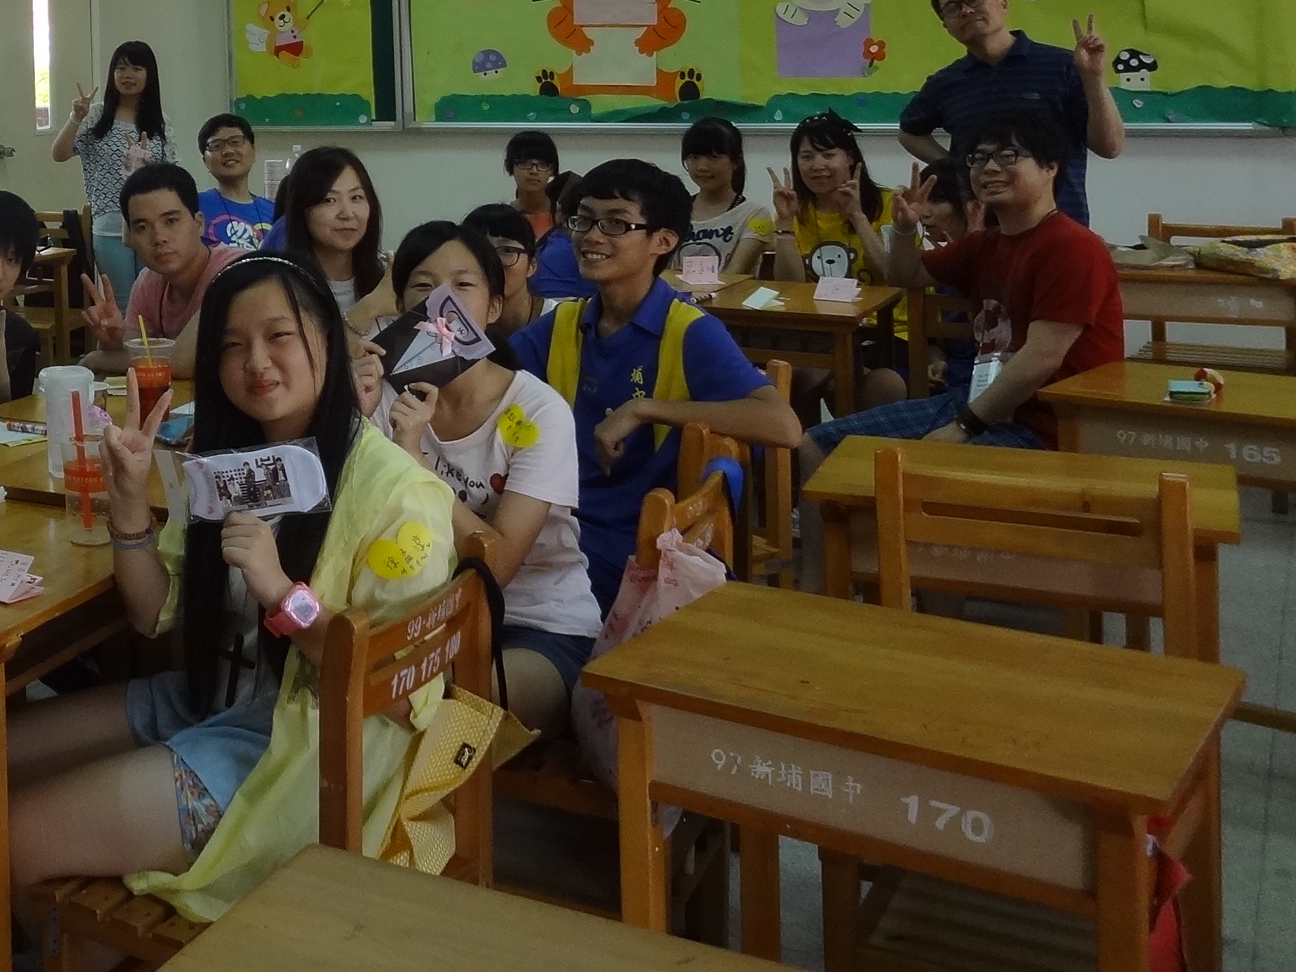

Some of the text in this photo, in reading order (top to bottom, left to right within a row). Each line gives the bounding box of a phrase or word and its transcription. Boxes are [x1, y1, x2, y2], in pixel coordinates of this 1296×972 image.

[1223, 442, 1283, 465] 165
[391, 664, 415, 700] 170
[421, 646, 442, 681] 175
[901, 794, 994, 844] 170
